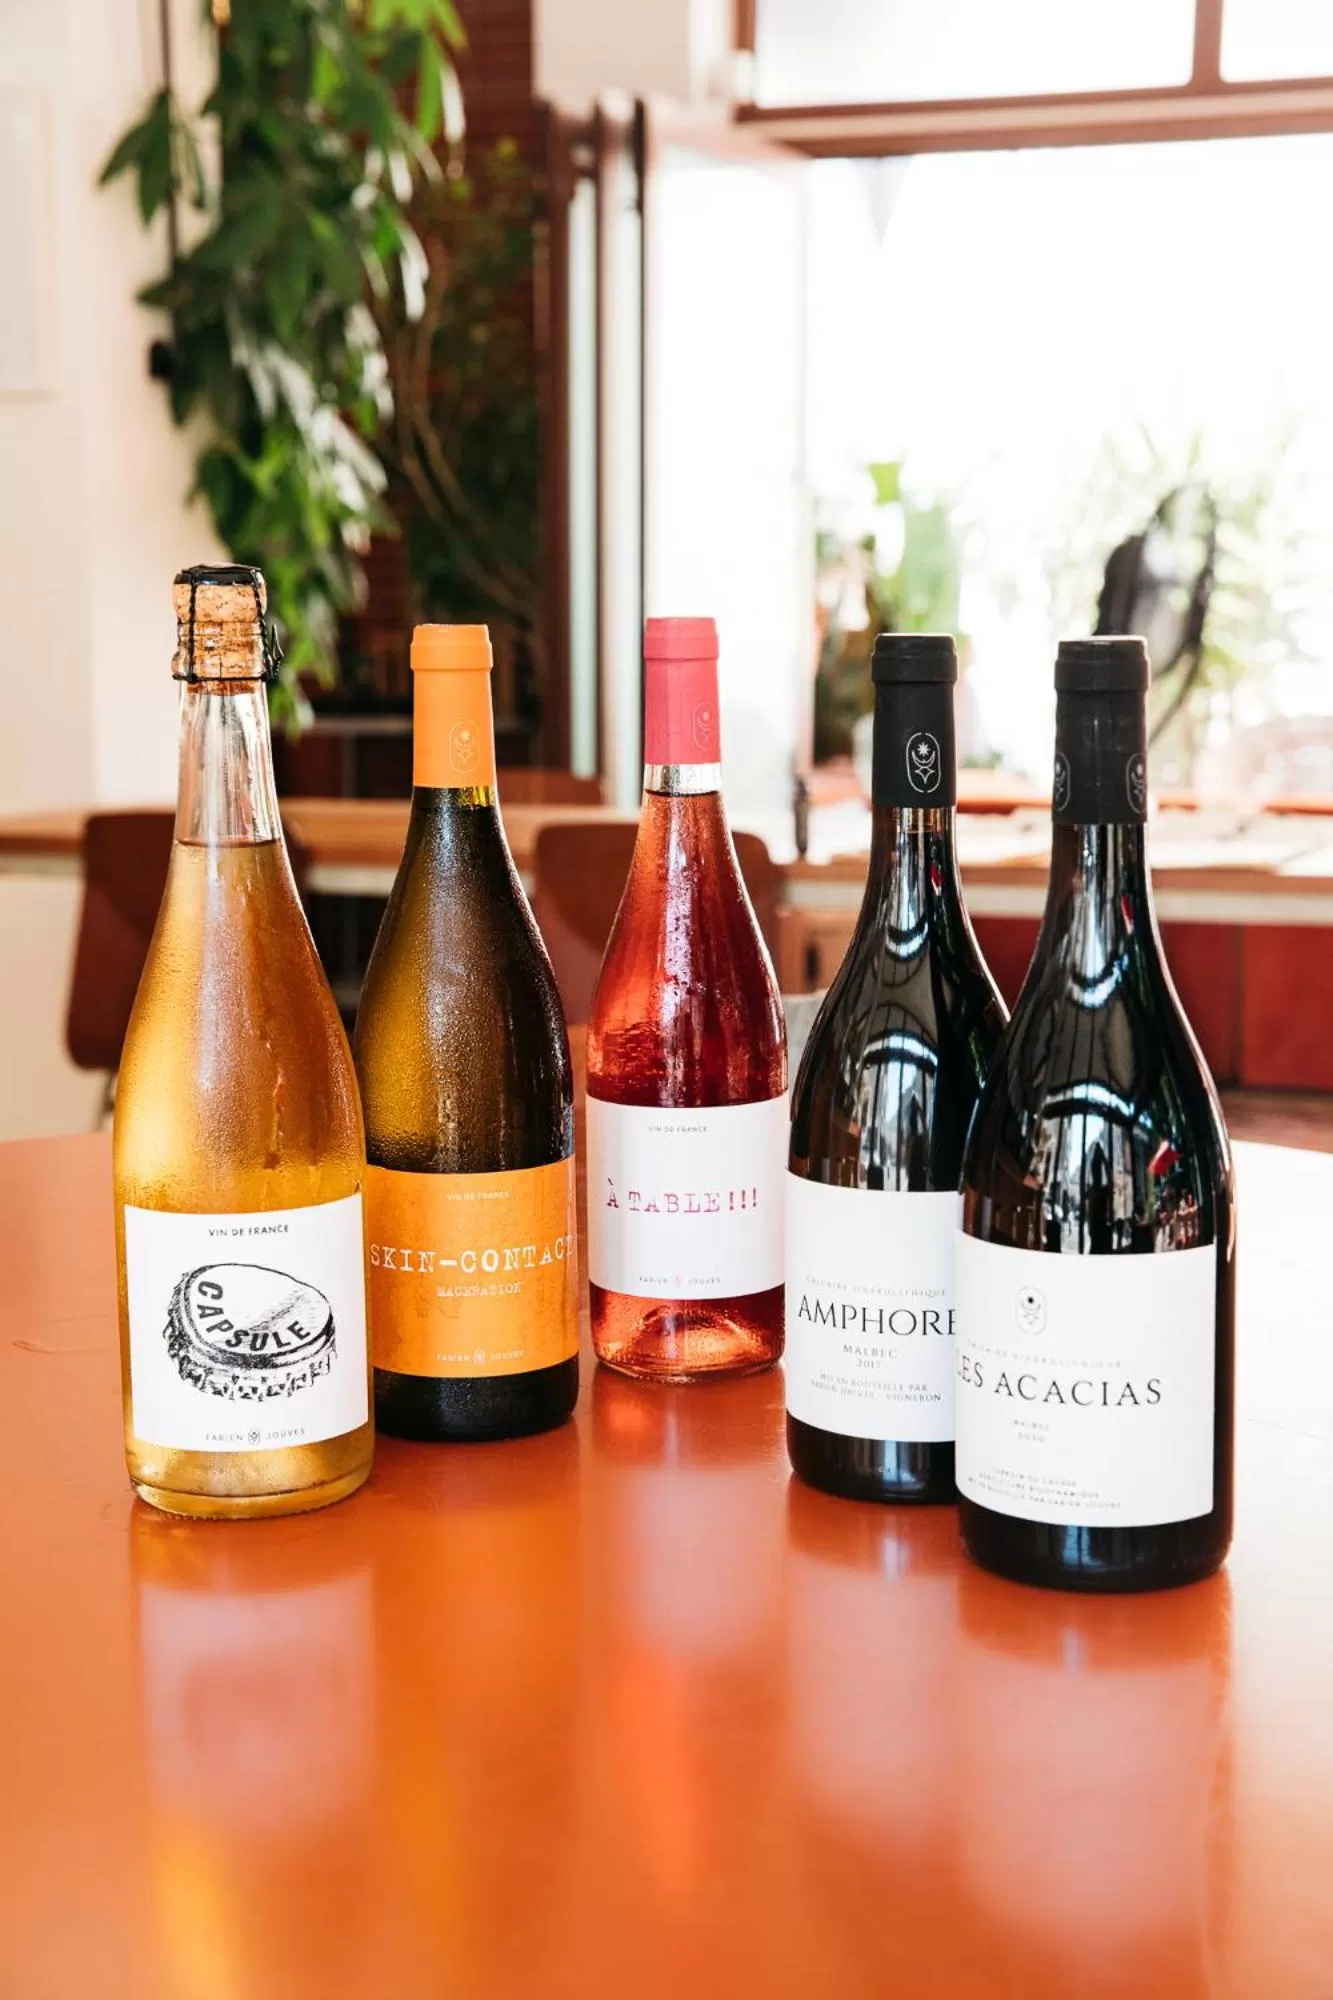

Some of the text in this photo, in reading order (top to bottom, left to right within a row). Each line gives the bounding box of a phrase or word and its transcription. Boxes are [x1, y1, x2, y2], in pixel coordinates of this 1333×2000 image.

[606, 1177, 620, 1209] À
[208, 1224, 289, 1237] VIN DE FRANCE
[197, 1281, 311, 1351] CAPSULE
[843, 1343, 899, 1359] MALBEC
[908, 1383, 928, 1392] PAR
[994, 1371, 1163, 1407] ACACIAS
[205, 1427, 306, 1441] FABIEN JOUVES
